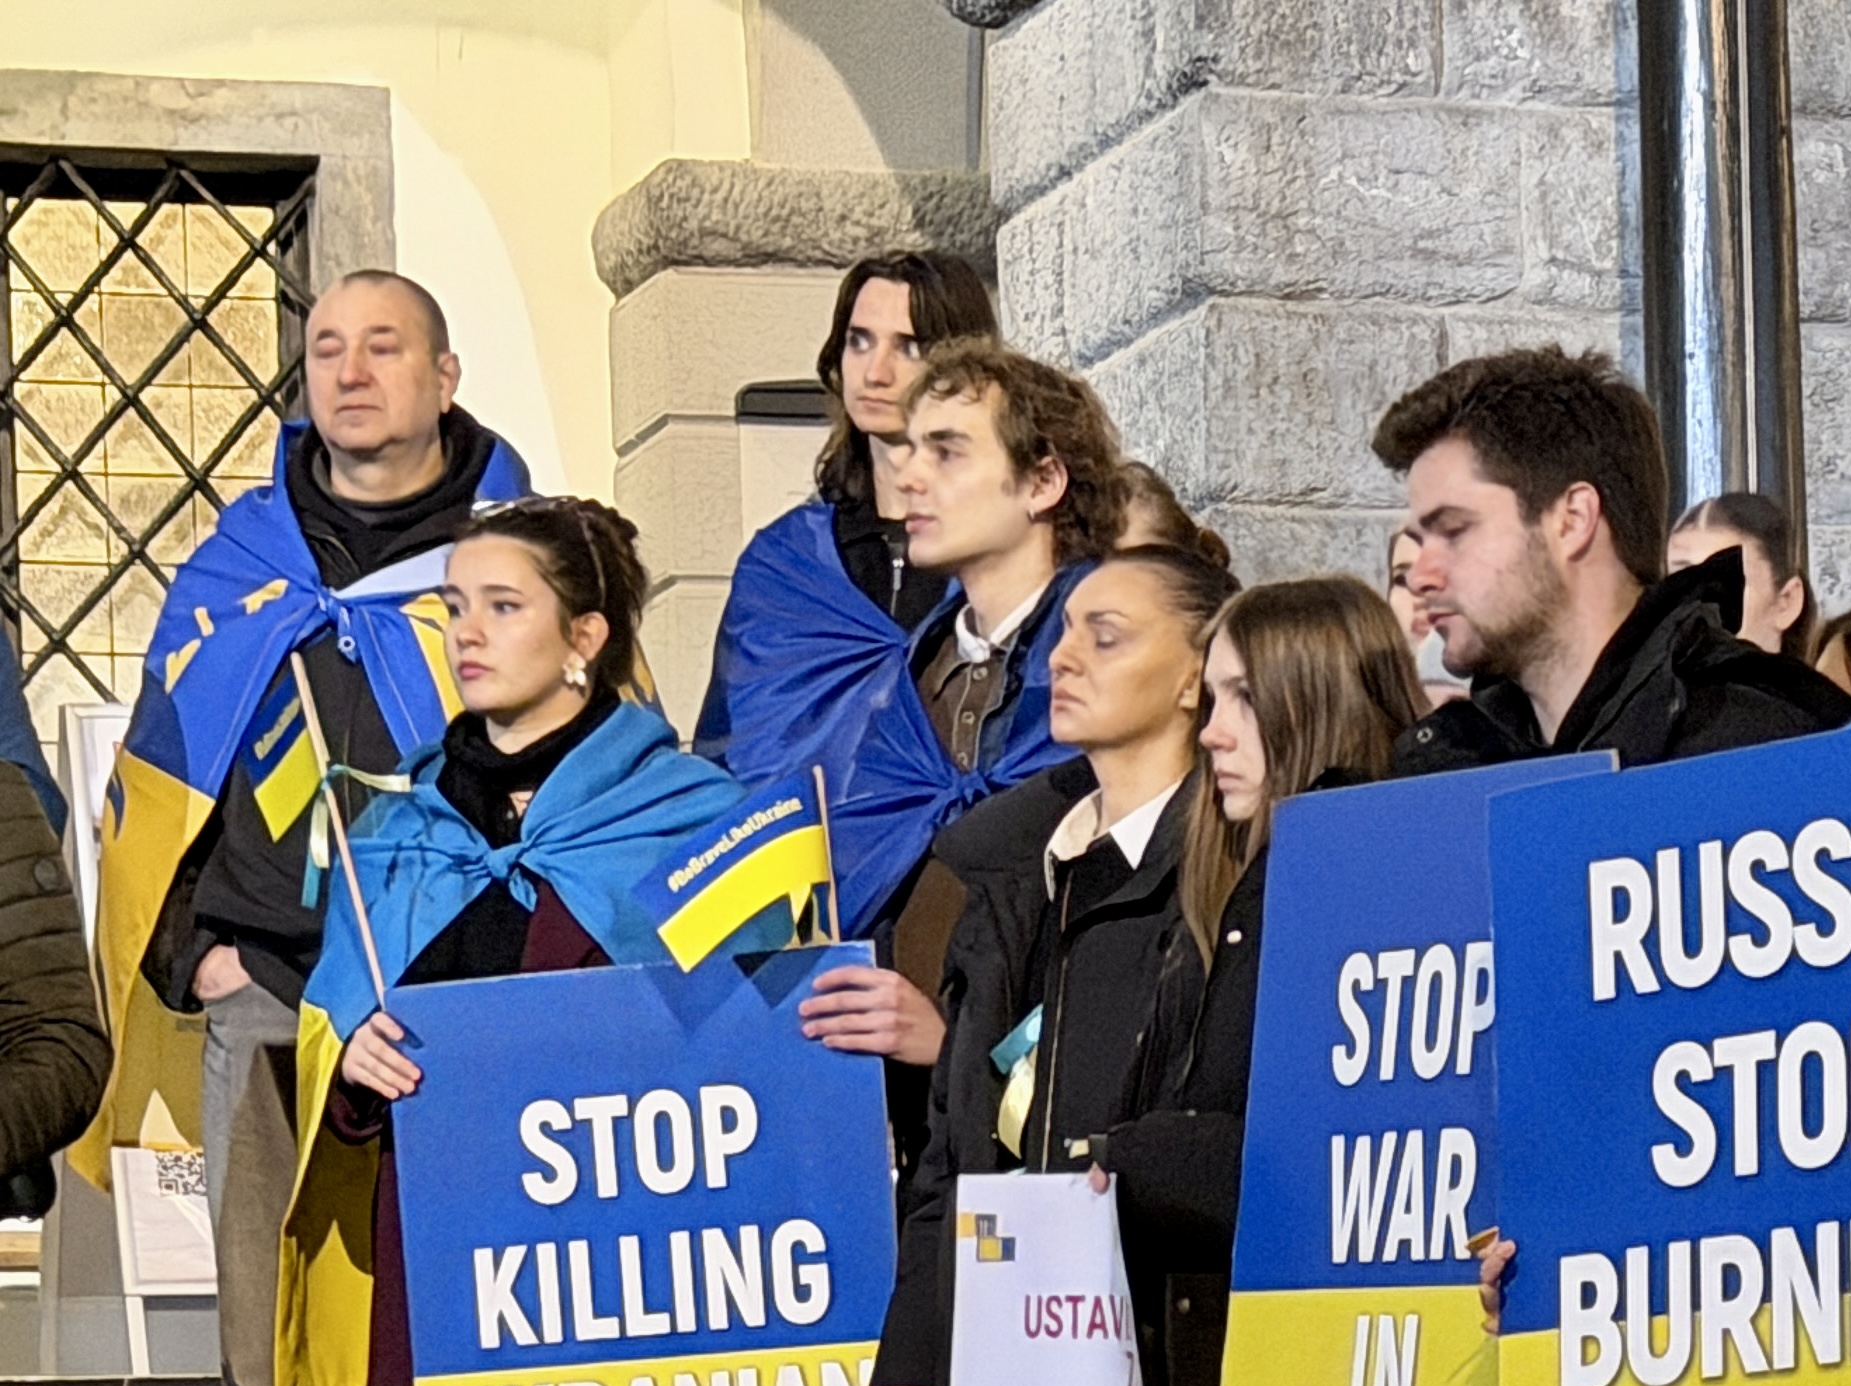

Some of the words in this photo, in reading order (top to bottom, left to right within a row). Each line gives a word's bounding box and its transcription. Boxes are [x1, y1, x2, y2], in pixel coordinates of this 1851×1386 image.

[1333, 942, 1495, 1086] STOP
[519, 1084, 758, 1205] STOP
[1331, 1128, 1473, 1263] WAR
[473, 1219, 830, 1350] KILLING
